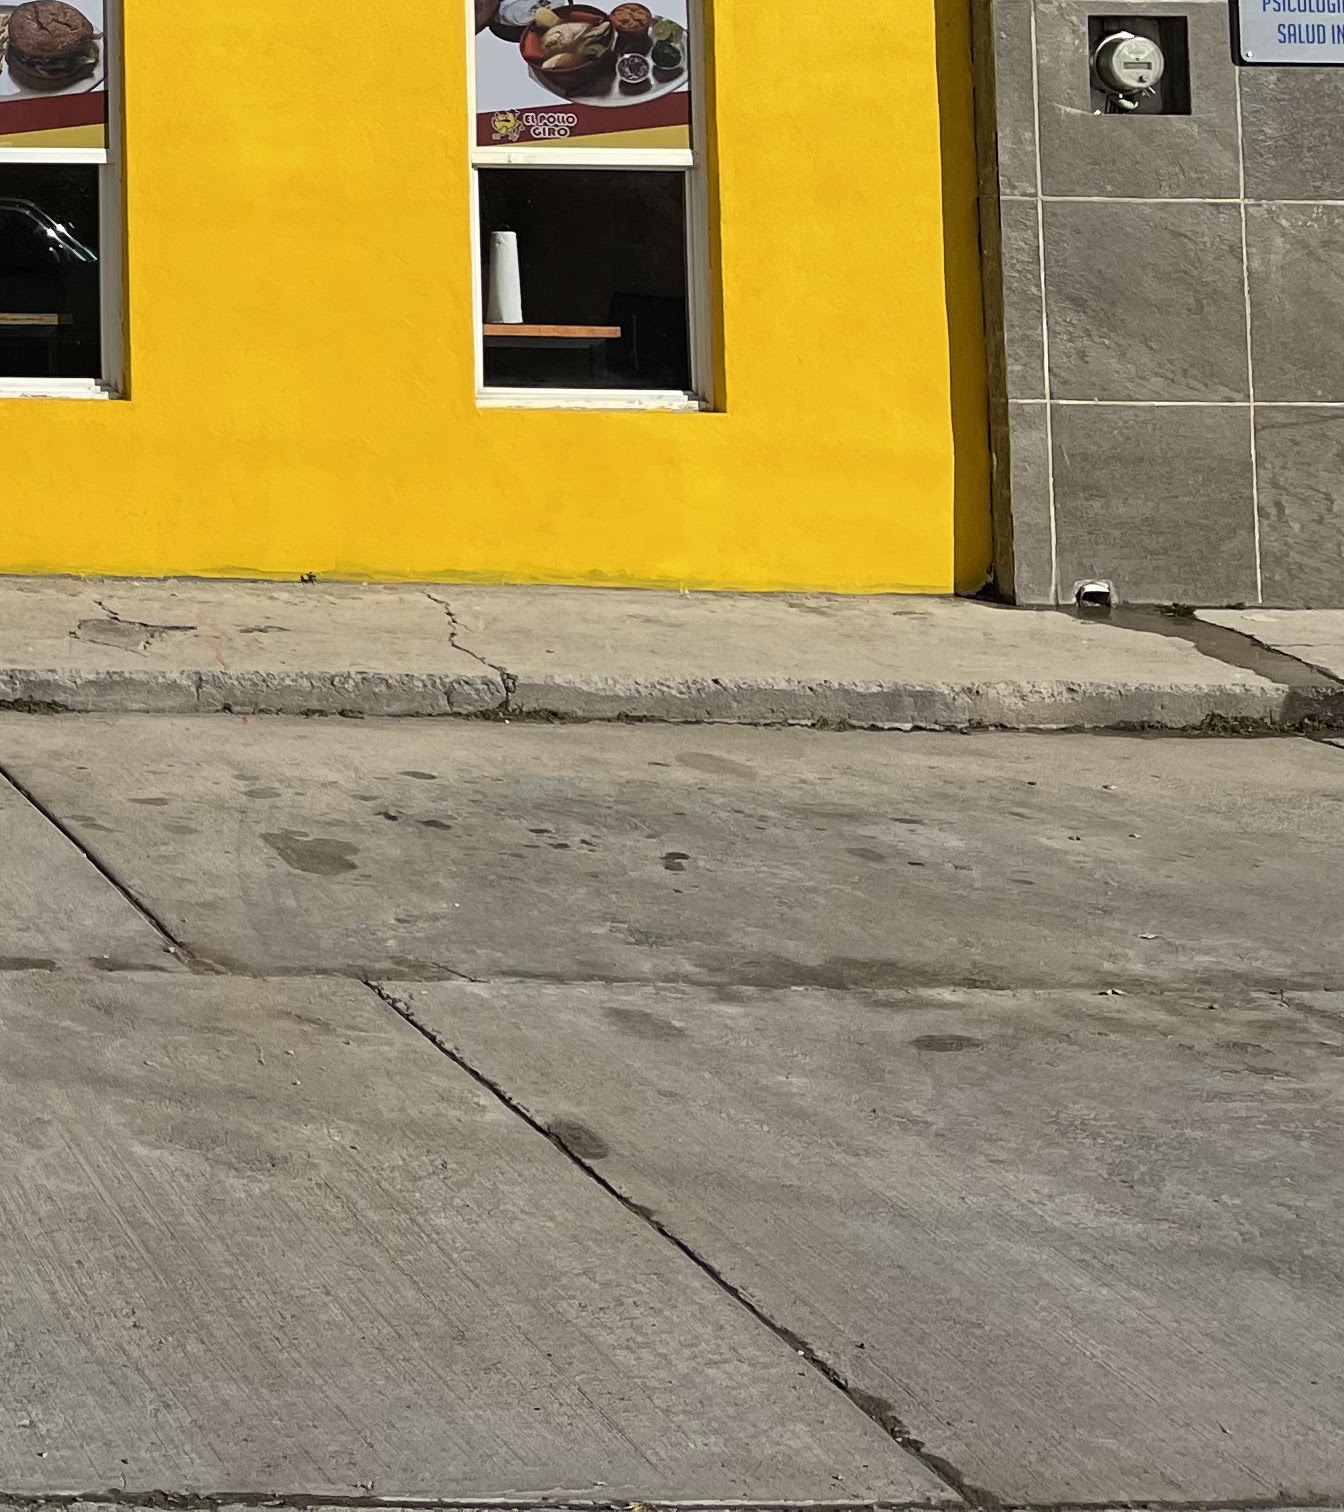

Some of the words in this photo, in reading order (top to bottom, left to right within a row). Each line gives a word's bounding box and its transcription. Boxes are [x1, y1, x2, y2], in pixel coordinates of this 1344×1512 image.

[1278, 24, 1326, 44] SALUD
[524, 114, 536, 125] EL
[539, 113, 577, 125] POLLO
[531, 125, 570, 138] GIRO
